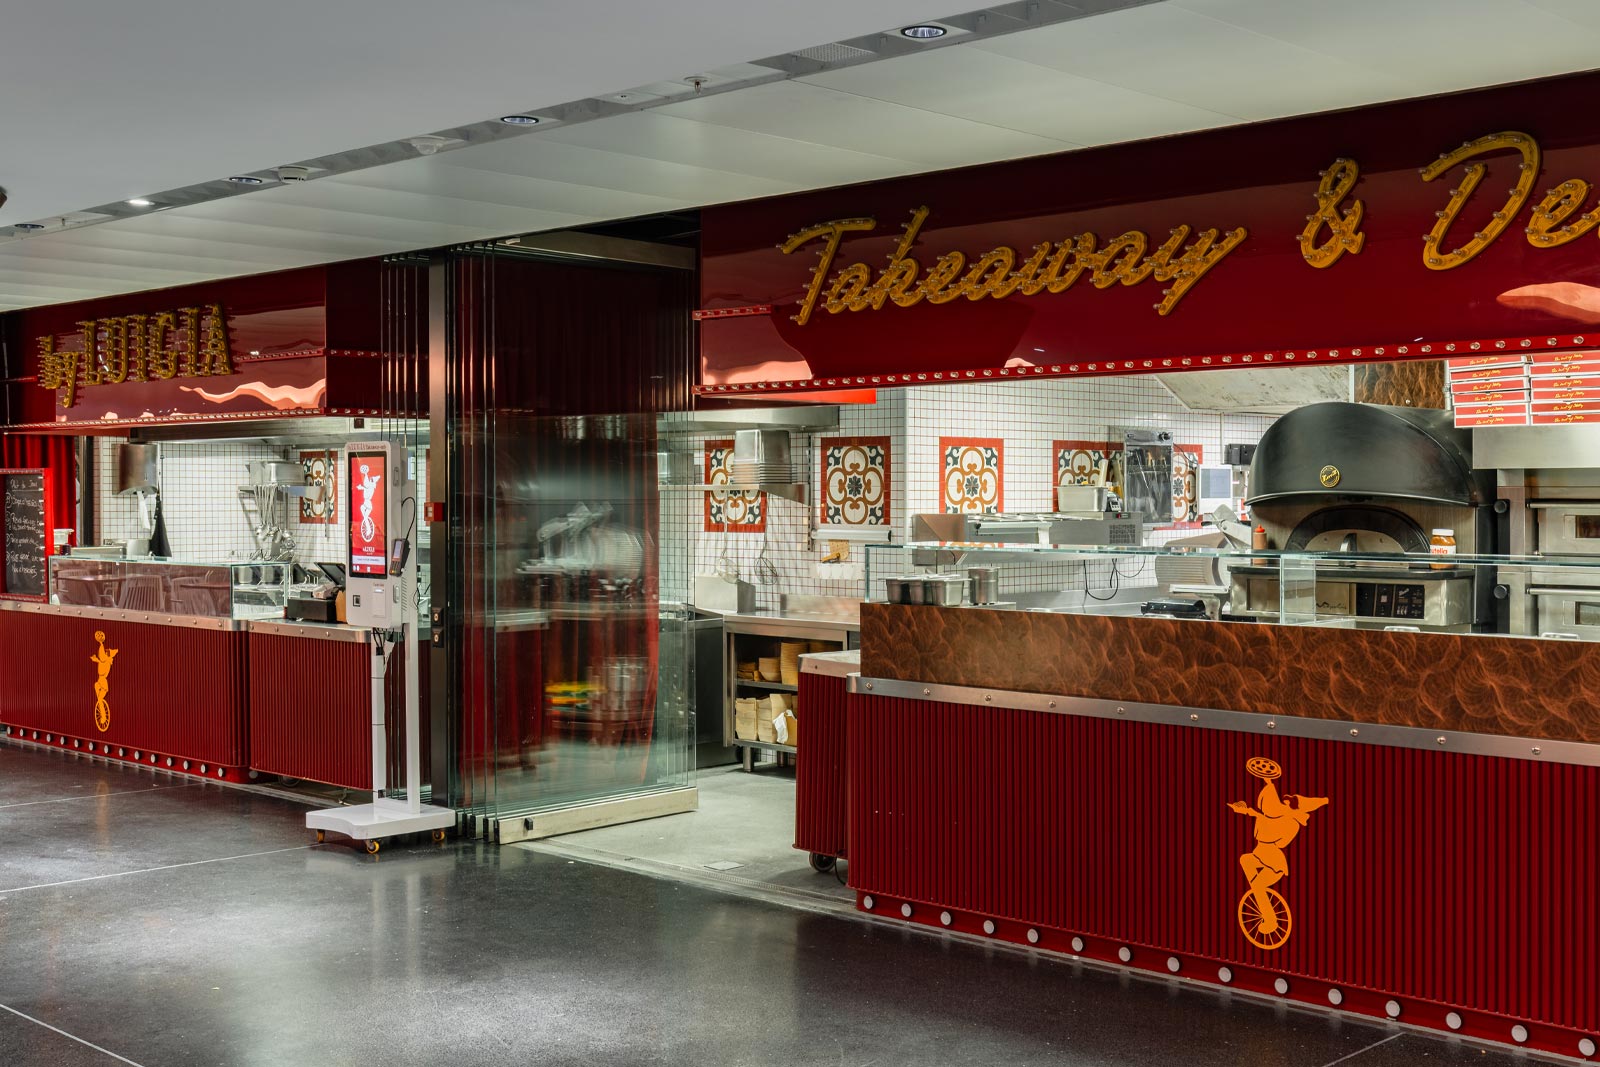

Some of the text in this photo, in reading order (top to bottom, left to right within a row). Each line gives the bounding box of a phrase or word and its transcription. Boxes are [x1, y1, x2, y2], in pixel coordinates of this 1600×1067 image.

[779, 130, 1600, 326] Takeaway & De
[38, 303, 233, 408] by LUIGIA
[1431, 547, 1448, 555] utella
